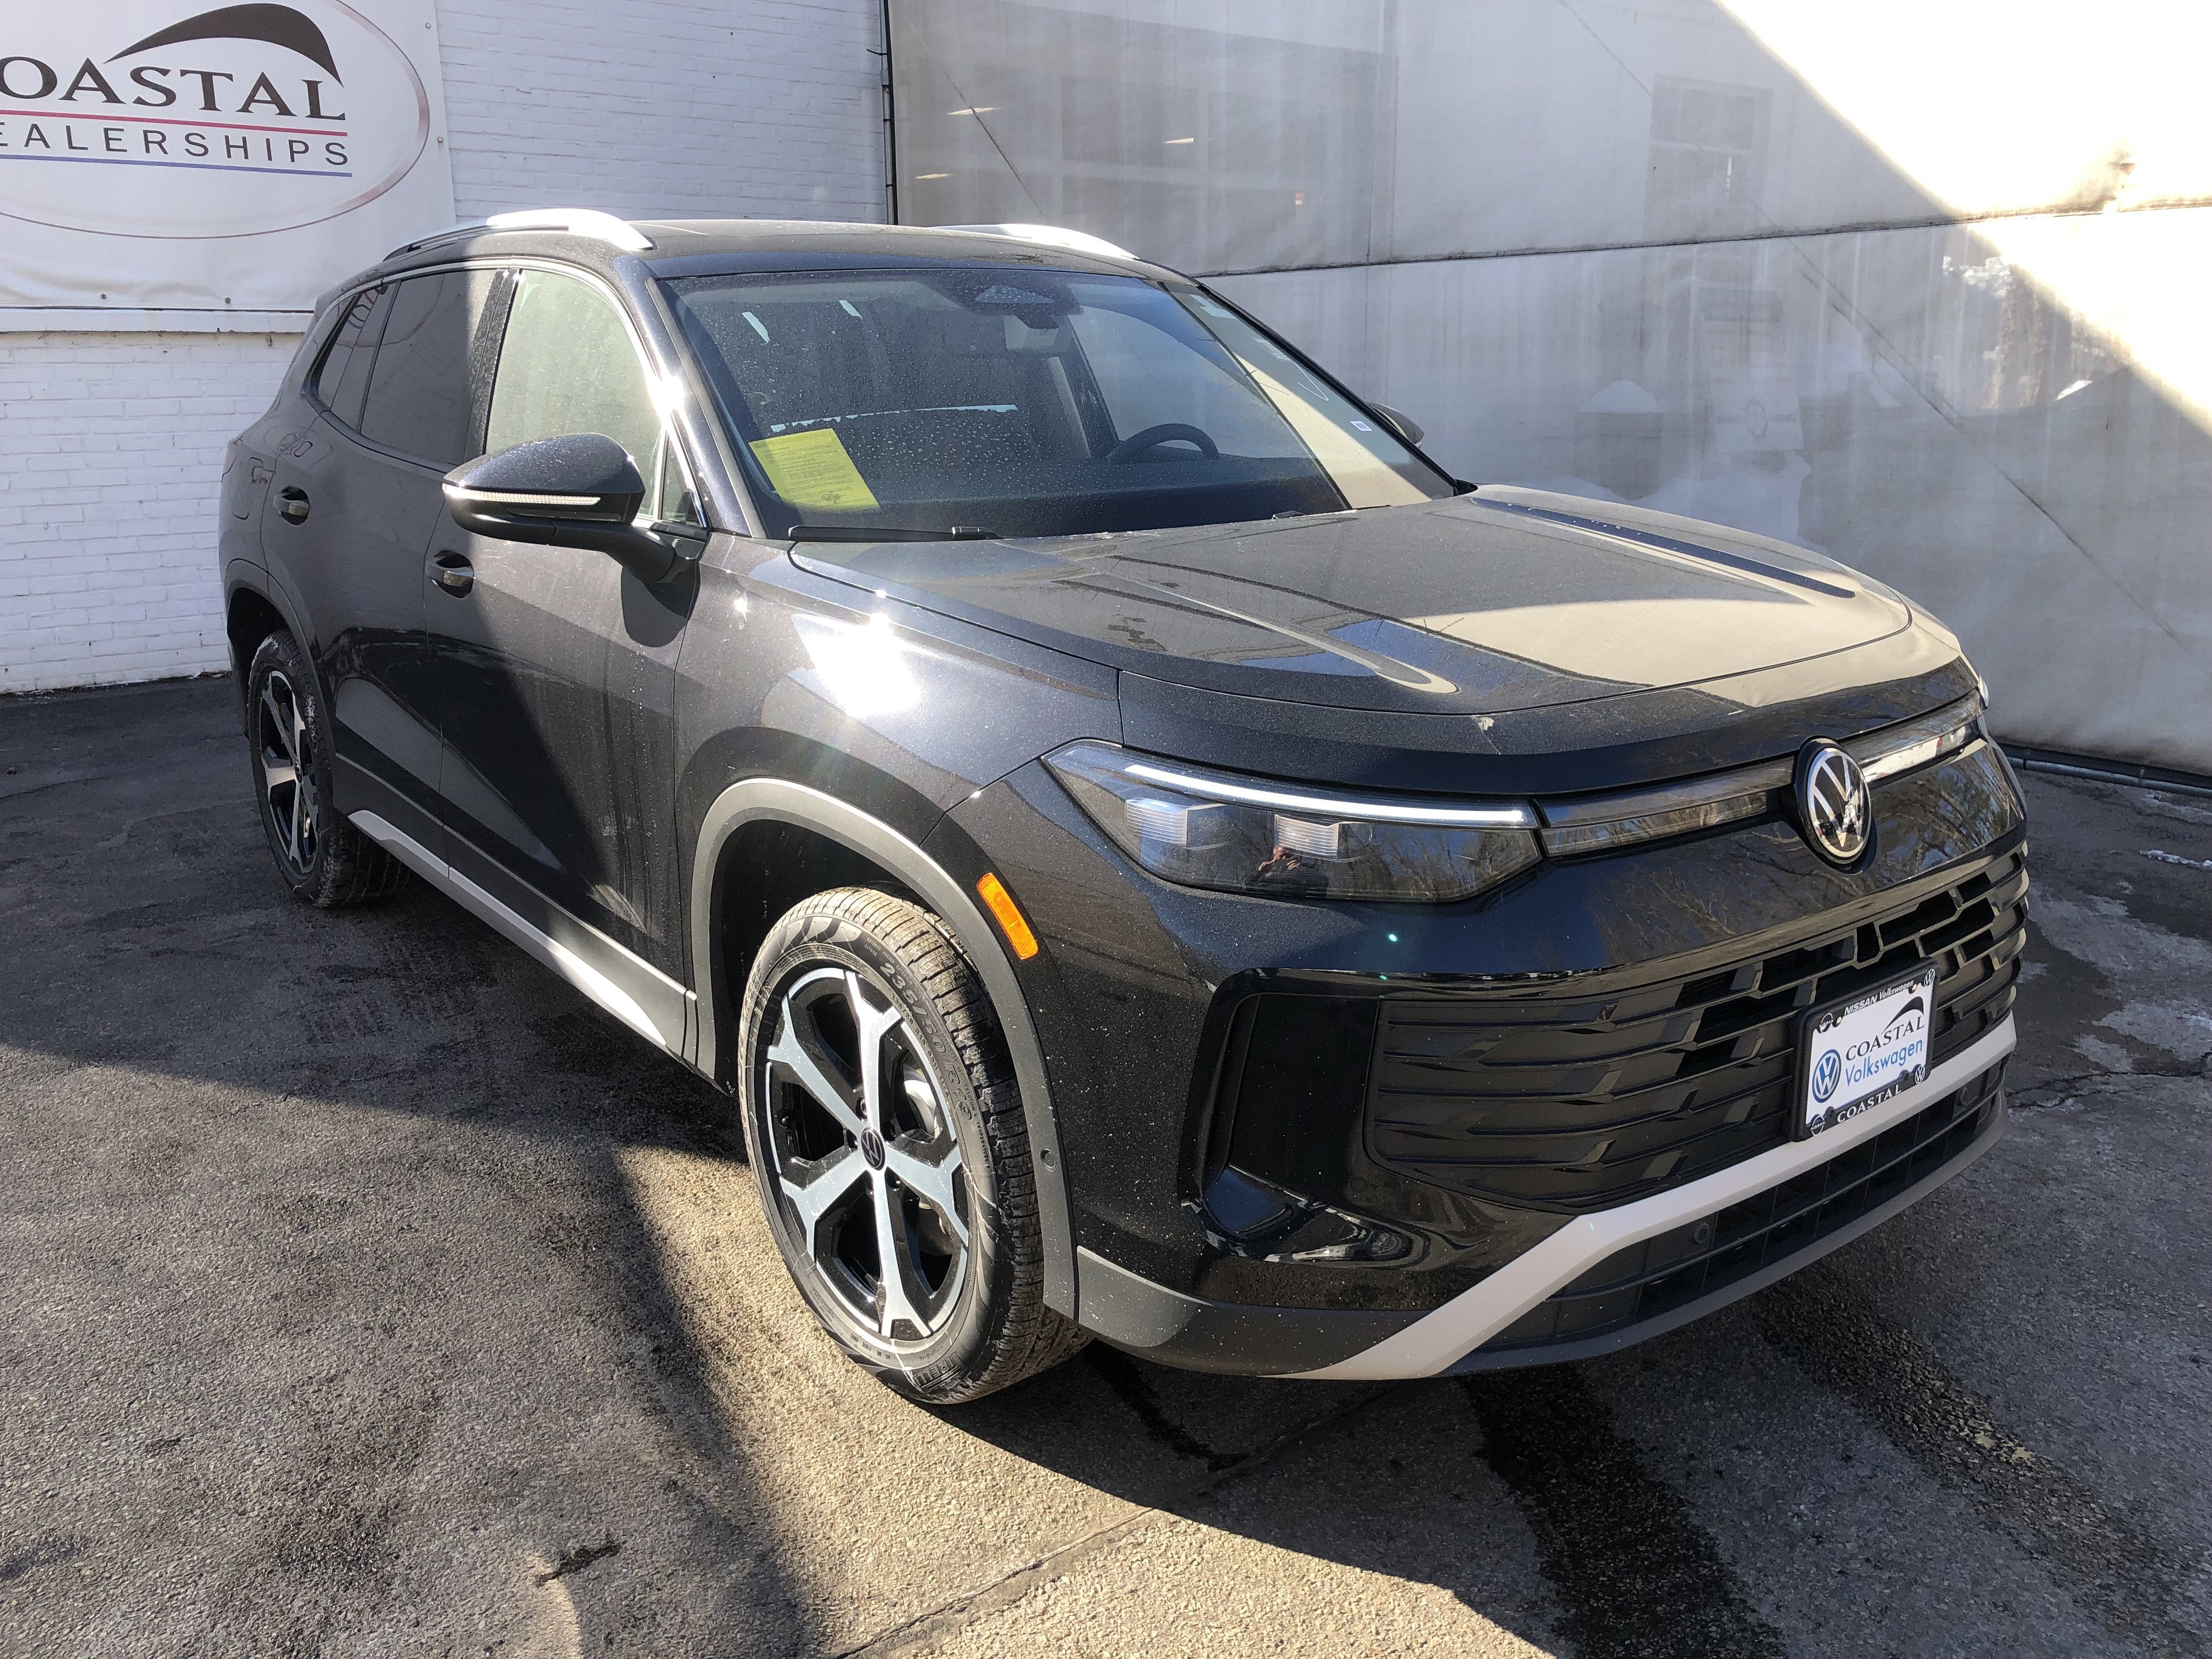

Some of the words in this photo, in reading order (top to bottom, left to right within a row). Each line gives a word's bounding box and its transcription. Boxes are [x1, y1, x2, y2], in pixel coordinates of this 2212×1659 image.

[0, 57, 346, 121] OASTAL
[879, 962, 946, 1053] 235/50
[1844, 994, 1878, 1015] NISSAN
[1879, 980, 1914, 1001] Volkswagen
[1846, 1015, 1925, 1061] COASTAL
[1845, 1039, 1923, 1087] Volkswagen
[1837, 1084, 1901, 1123] COASTAL
